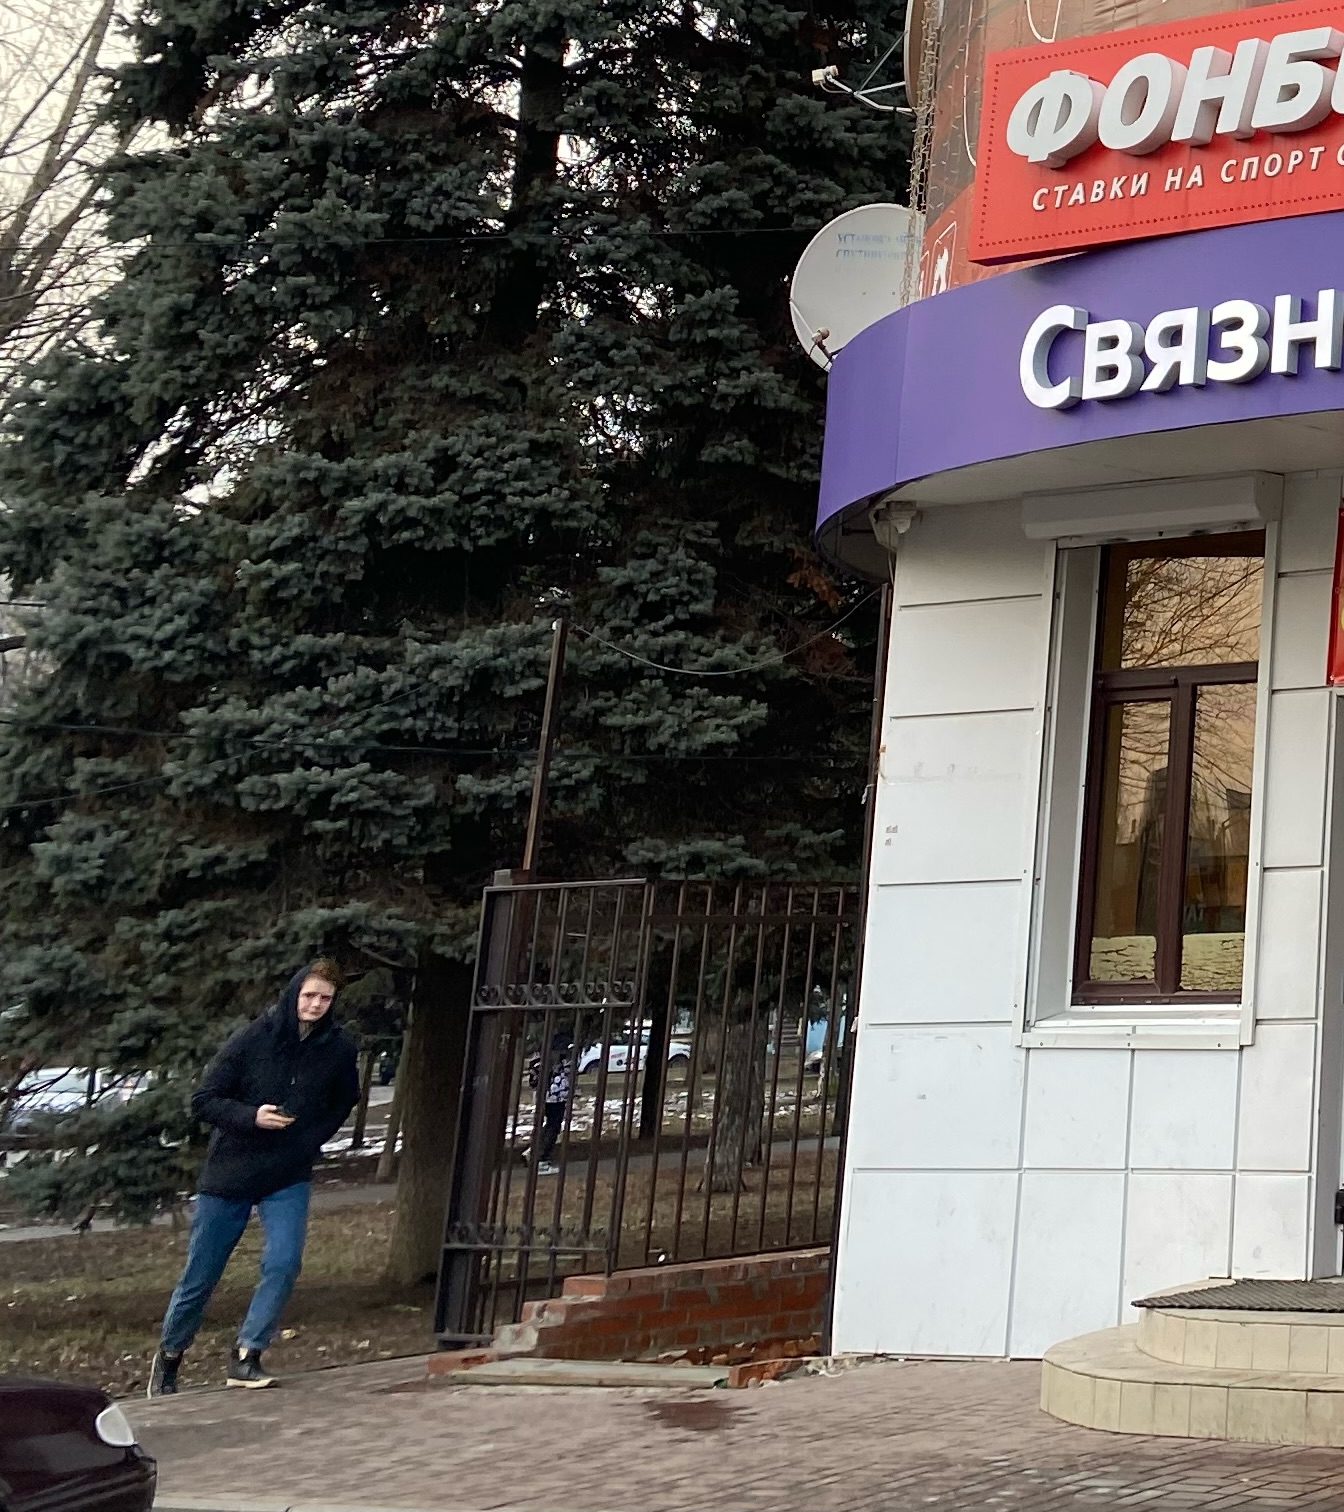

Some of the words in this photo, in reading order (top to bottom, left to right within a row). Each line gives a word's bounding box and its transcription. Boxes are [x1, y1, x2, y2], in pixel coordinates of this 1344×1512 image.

[1032, 172, 1149, 211] СТАВКИ
[1164, 165, 1204, 191] НА
[1220, 144, 1325, 183] СПОРТ
